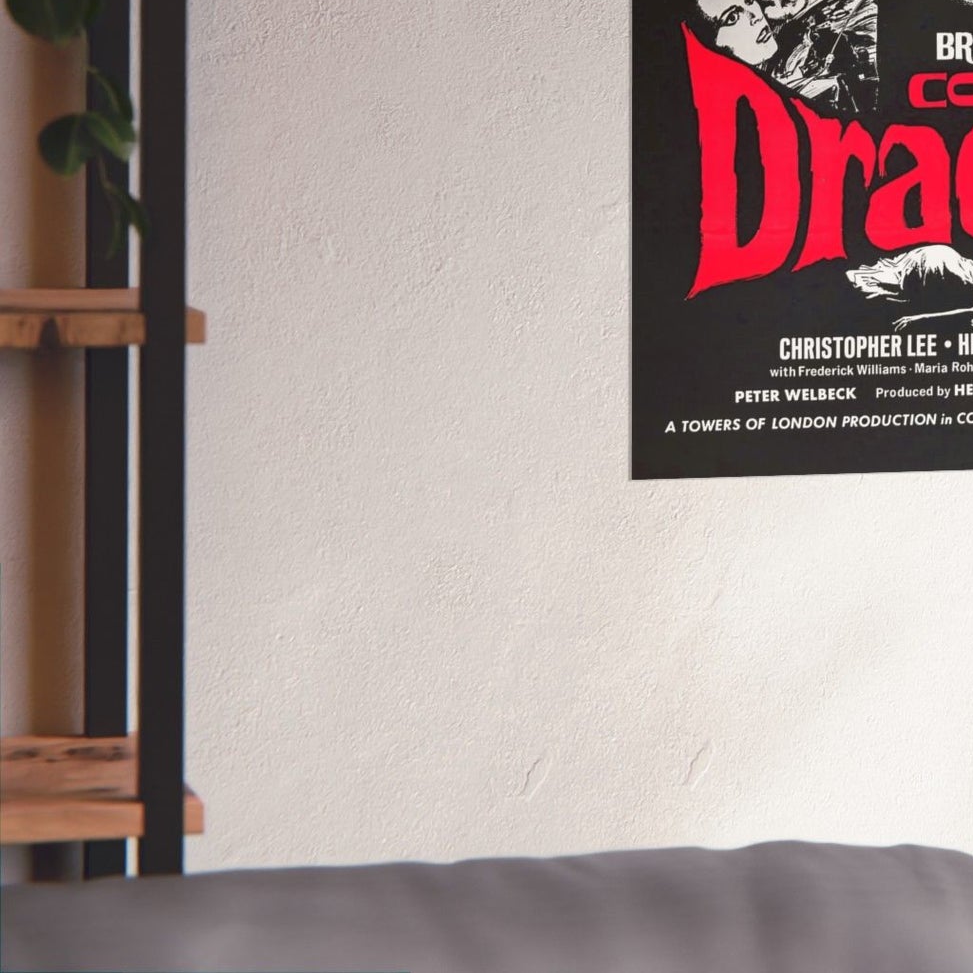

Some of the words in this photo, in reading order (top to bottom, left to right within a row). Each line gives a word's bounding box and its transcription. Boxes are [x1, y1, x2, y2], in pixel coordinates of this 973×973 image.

[779, 335, 901, 360] CHRISTOPHER
[907, 334, 937, 356] LEE
[770, 366, 796, 377] with
[798, 364, 854, 377] Frederick
[857, 363, 907, 375] Williams
[915, 362, 948, 373] Maria
[735, 389, 780, 403] PETER
[784, 387, 856, 401] WELBECK
[876, 386, 933, 399] Produced
[936, 385, 950, 399] by
[665, 421, 677, 433] A
[681, 418, 741, 433] TOWERS
[746, 418, 766, 431] OF
[772, 416, 837, 430] LONDON
[842, 413, 937, 428] PRODUCTION
[940, 413, 952, 425] in
